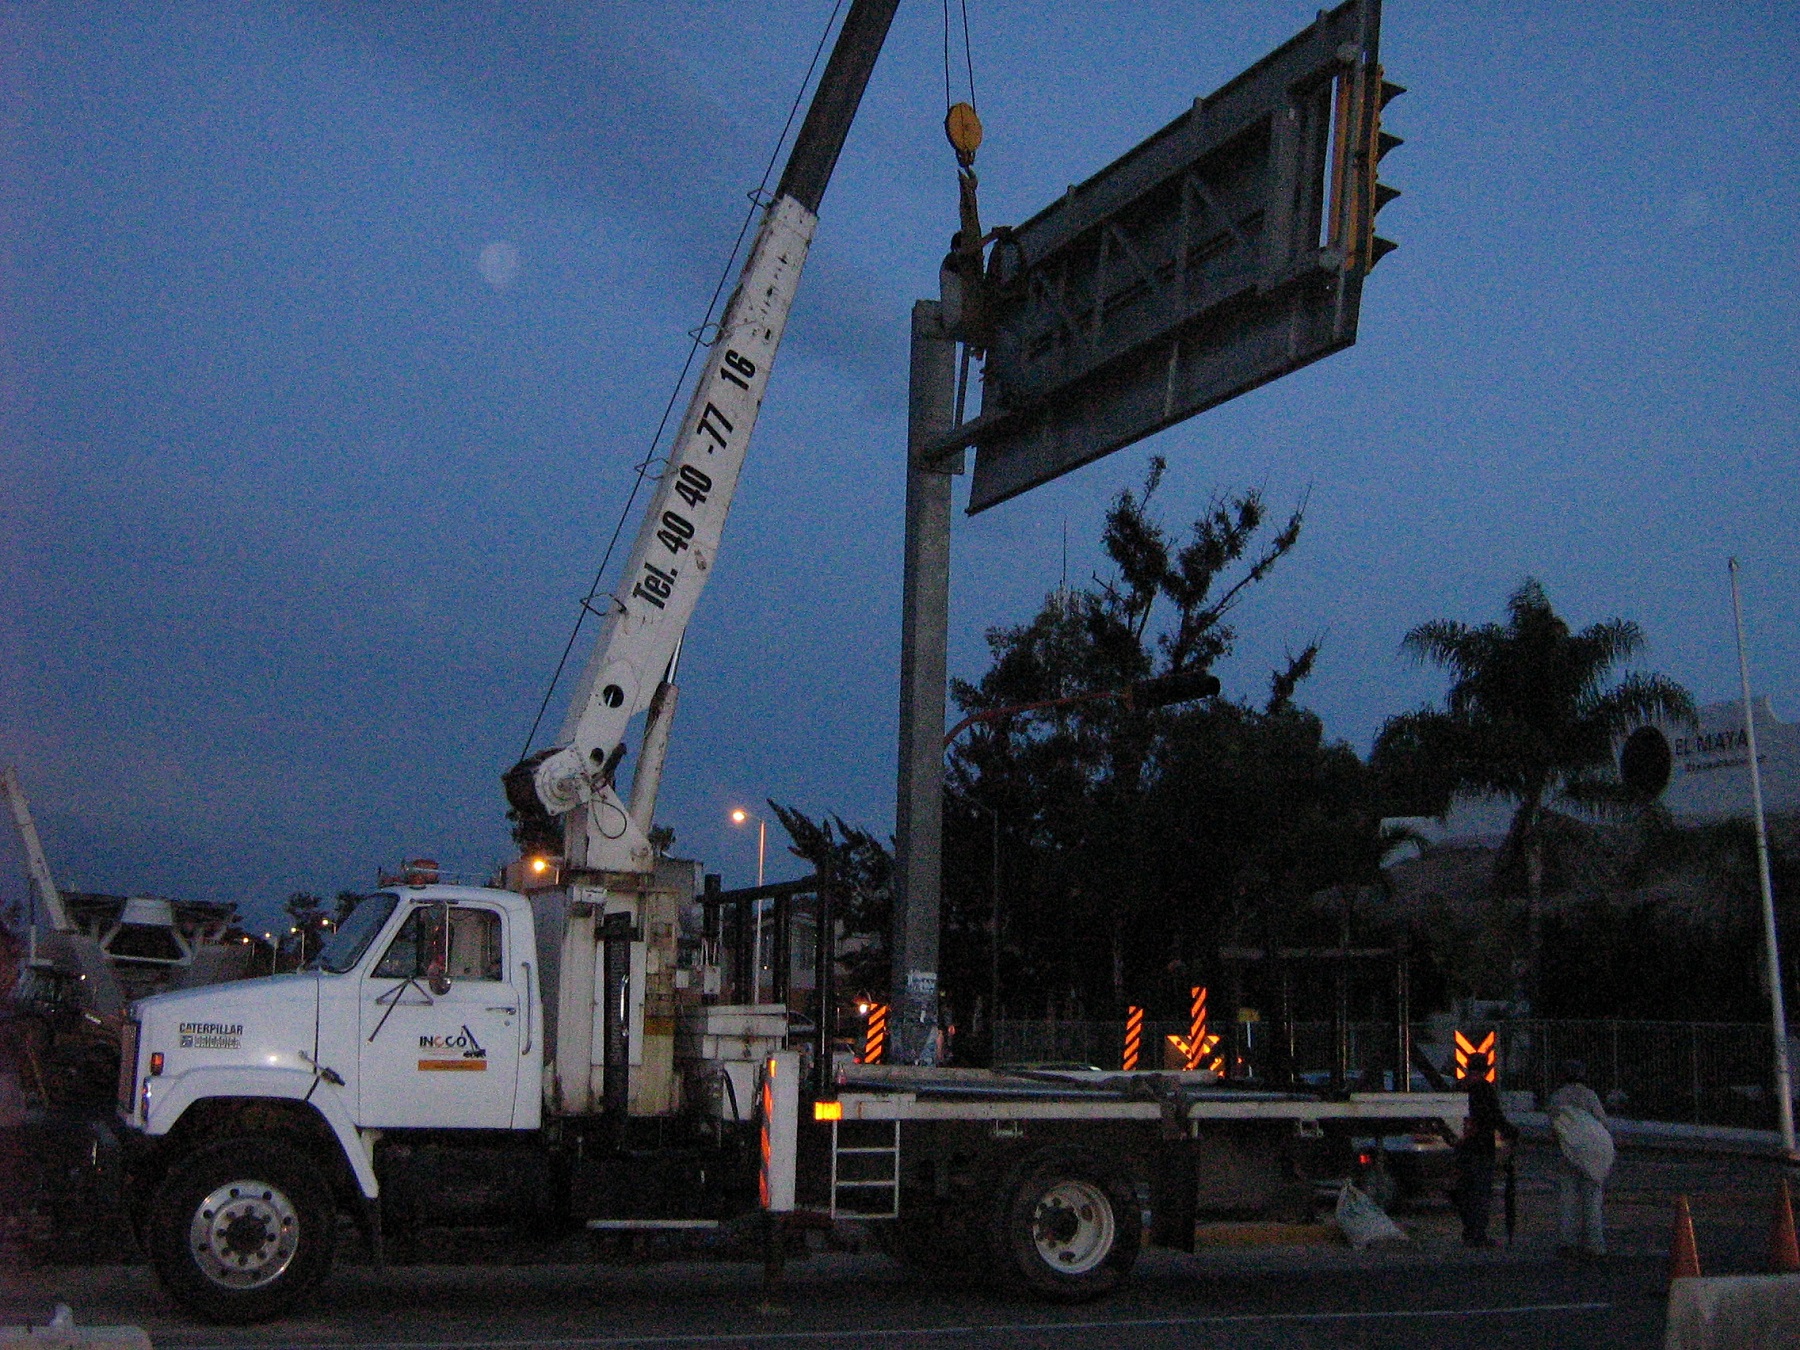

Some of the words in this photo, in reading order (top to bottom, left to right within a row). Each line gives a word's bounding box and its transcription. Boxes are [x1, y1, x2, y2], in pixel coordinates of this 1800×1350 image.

[720, 349, 756, 391] 16
[675, 464, 712, 508] 40
[656, 510, 695, 555] 40
[632, 562, 678, 610] Tel.
[179, 1022, 243, 1035] CATERPILLAR
